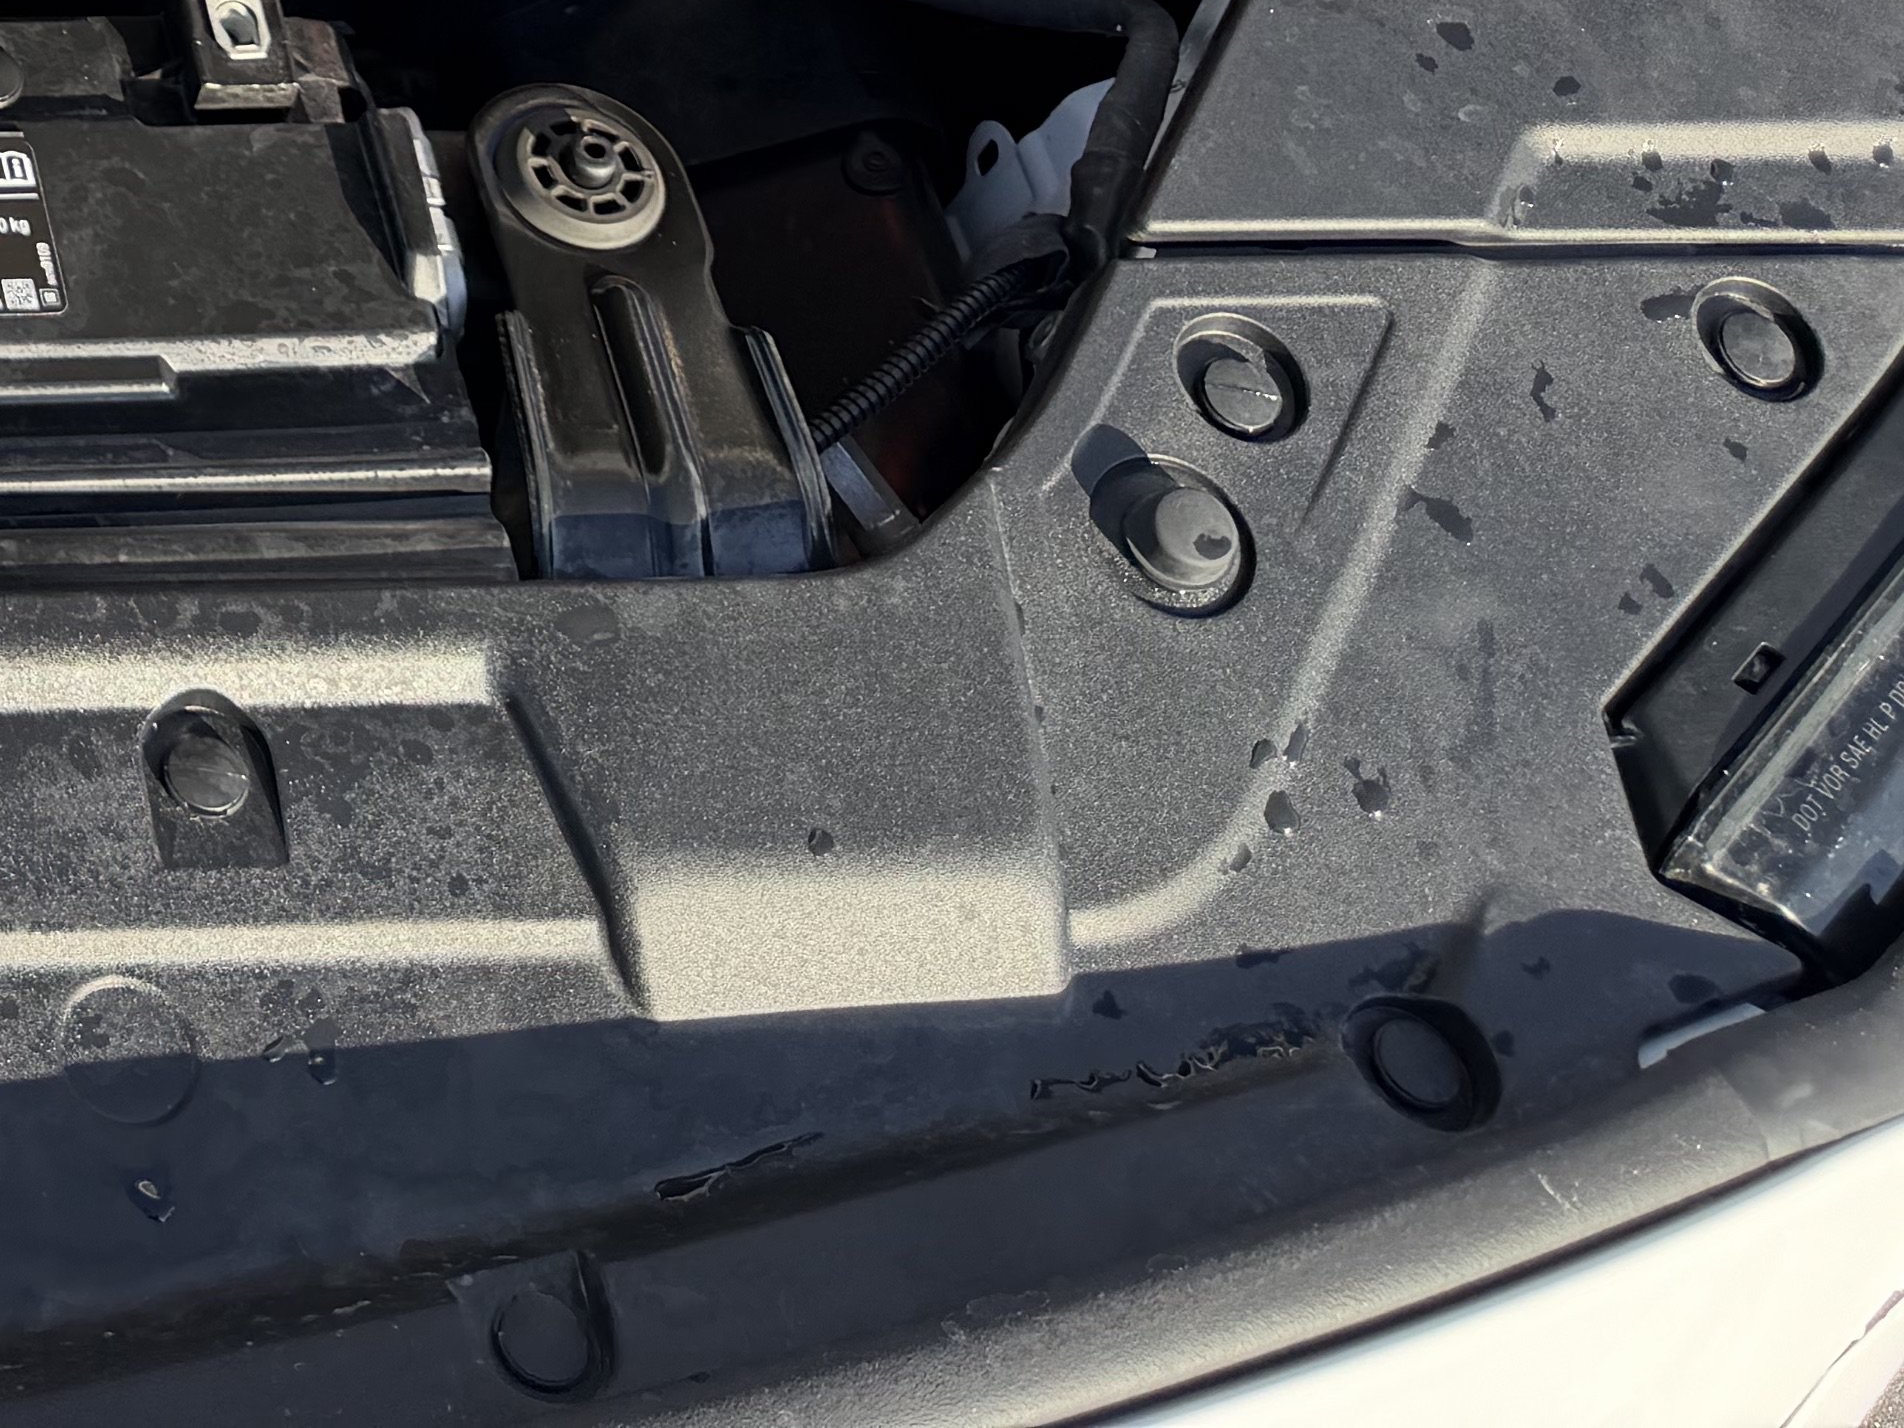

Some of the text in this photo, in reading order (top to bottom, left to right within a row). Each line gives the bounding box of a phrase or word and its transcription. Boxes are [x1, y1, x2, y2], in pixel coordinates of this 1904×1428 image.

[9, 216, 31, 236] kg
[1792, 702, 1896, 832] DOT VOR SAE HL P
